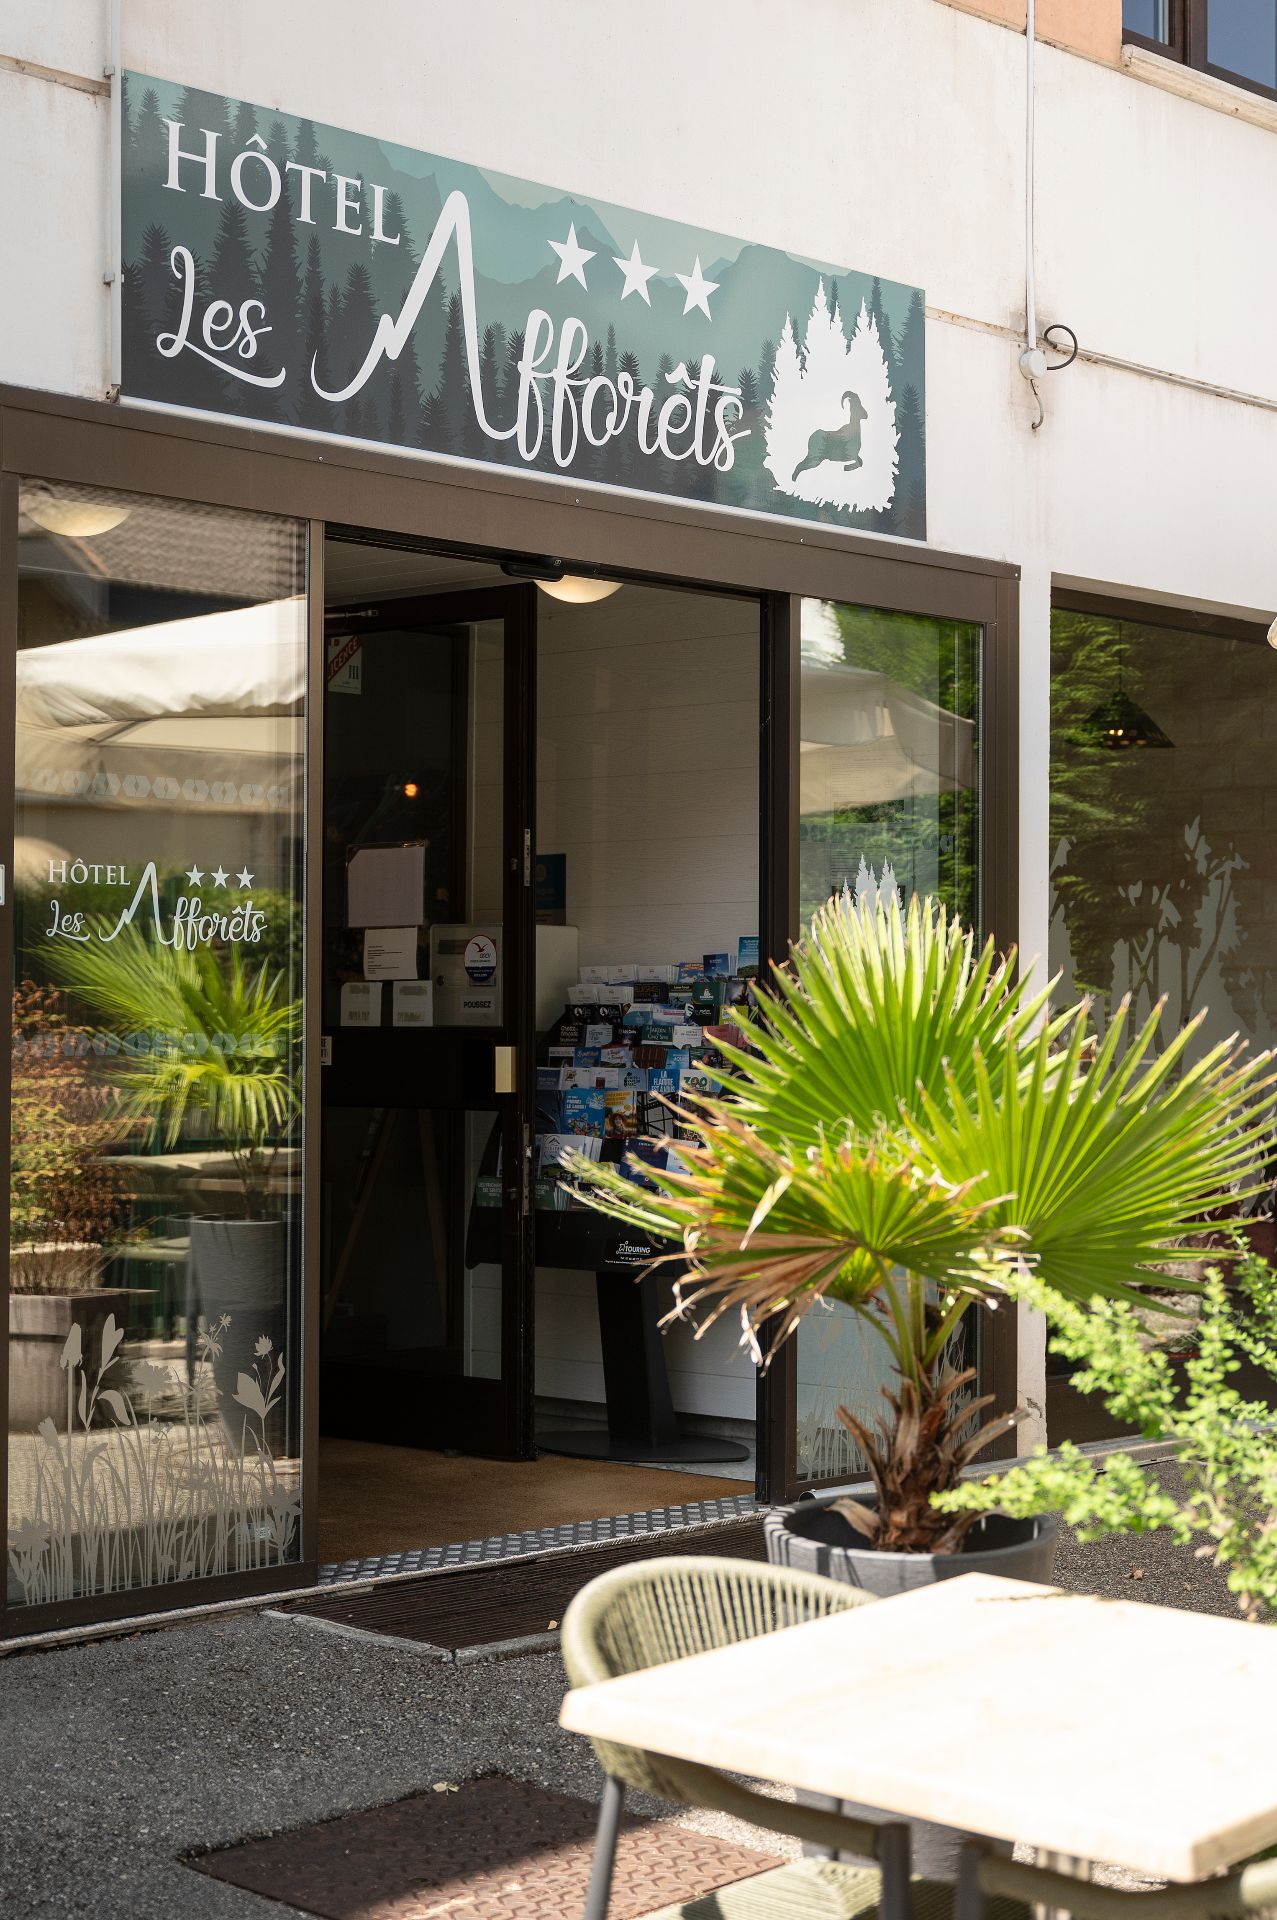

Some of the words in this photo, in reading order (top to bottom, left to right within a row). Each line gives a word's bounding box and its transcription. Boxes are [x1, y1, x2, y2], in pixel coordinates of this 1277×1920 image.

[162, 119, 401, 247] HÔTEL
[156, 245, 285, 388] Les
[310, 190, 752, 473] Afforêts
[47, 857, 131, 886] HÔTEL
[46, 899, 91, 942] Les
[98, 861, 268, 951] Afforêts
[463, 1000, 491, 1009] POUSSEZ
[660, 1070, 668, 1079] LA
[683, 1076, 708, 1088] ZOO
[625, 1245, 651, 1254] TOURING
